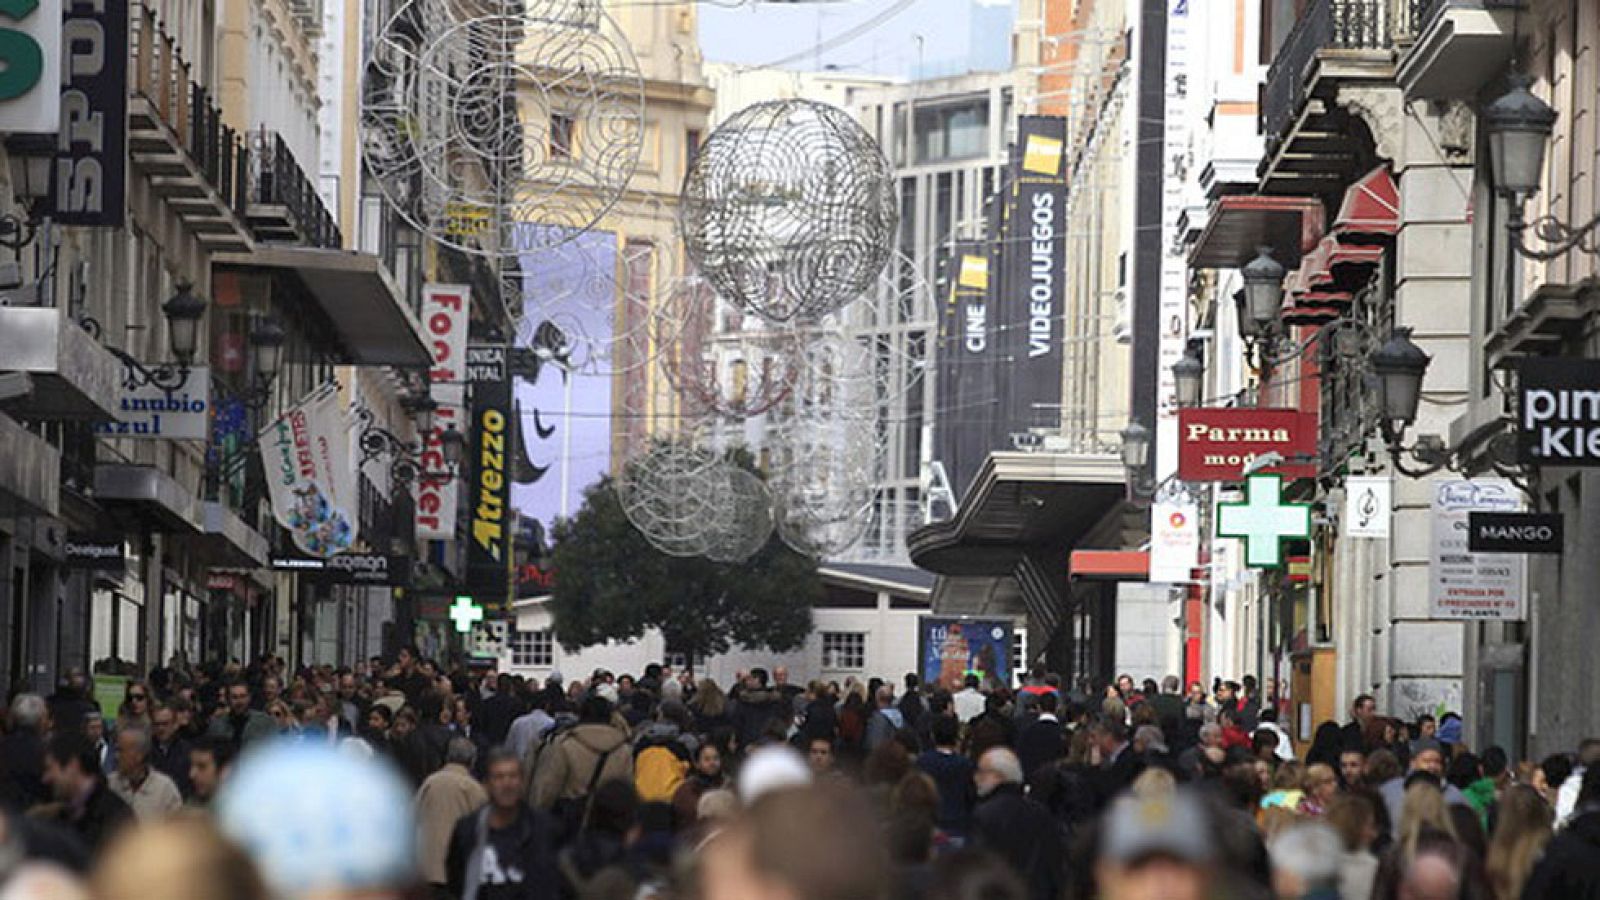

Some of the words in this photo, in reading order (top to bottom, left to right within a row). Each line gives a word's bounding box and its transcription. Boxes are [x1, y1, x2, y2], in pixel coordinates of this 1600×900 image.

[58, 0, 105, 212] SPO
[1027, 192, 1055, 357] VIDEOJUEGOS
[966, 304, 987, 353] CINE
[1186, 423, 1290, 443] Parma
[1203, 451, 1256, 466] mod
[473, 408, 505, 562] Atrezzo
[1480, 525, 1553, 542] MANGO
